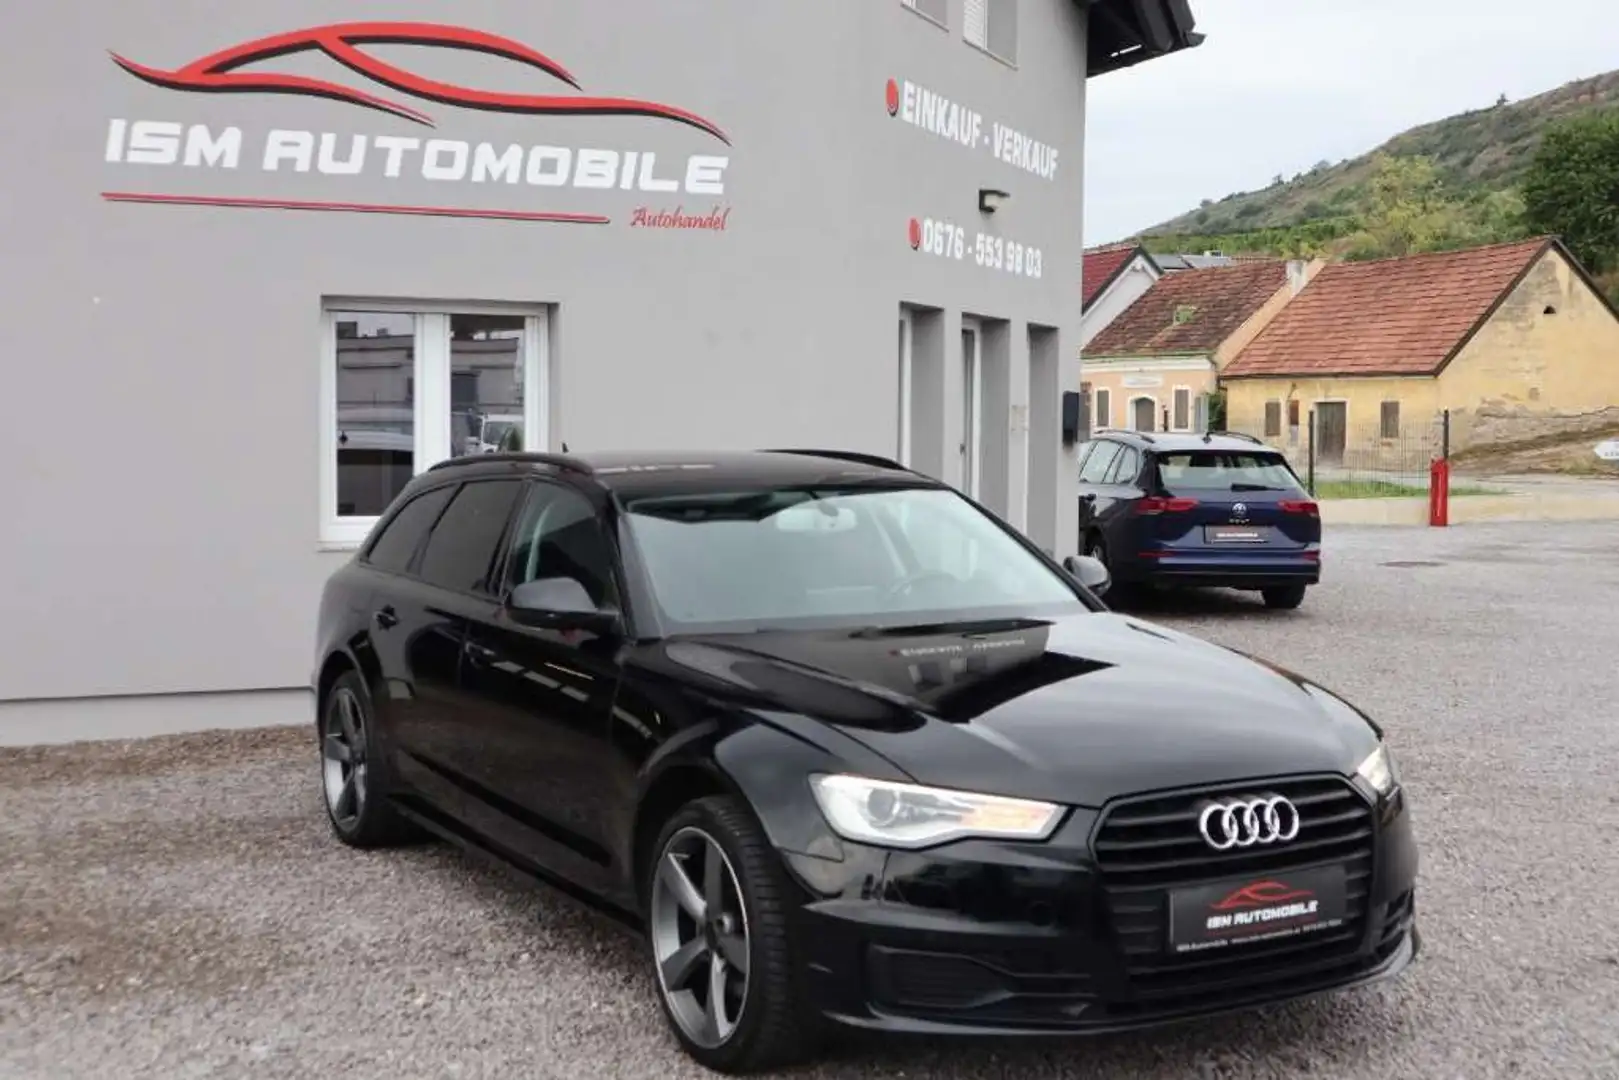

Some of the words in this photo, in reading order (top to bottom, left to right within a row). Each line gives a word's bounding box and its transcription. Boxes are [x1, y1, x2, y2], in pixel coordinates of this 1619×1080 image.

[105, 117, 243, 169] ISM
[262, 129, 729, 195] AUTOMOBILE
[901, 79, 982, 149] EINKAUF
[992, 121, 1059, 181] VERKAUF
[630, 203, 731, 231] Autohandel
[923, 217, 965, 260] 0676
[975, 232, 1003, 269] 553
[1025, 246, 1042, 278] 03
